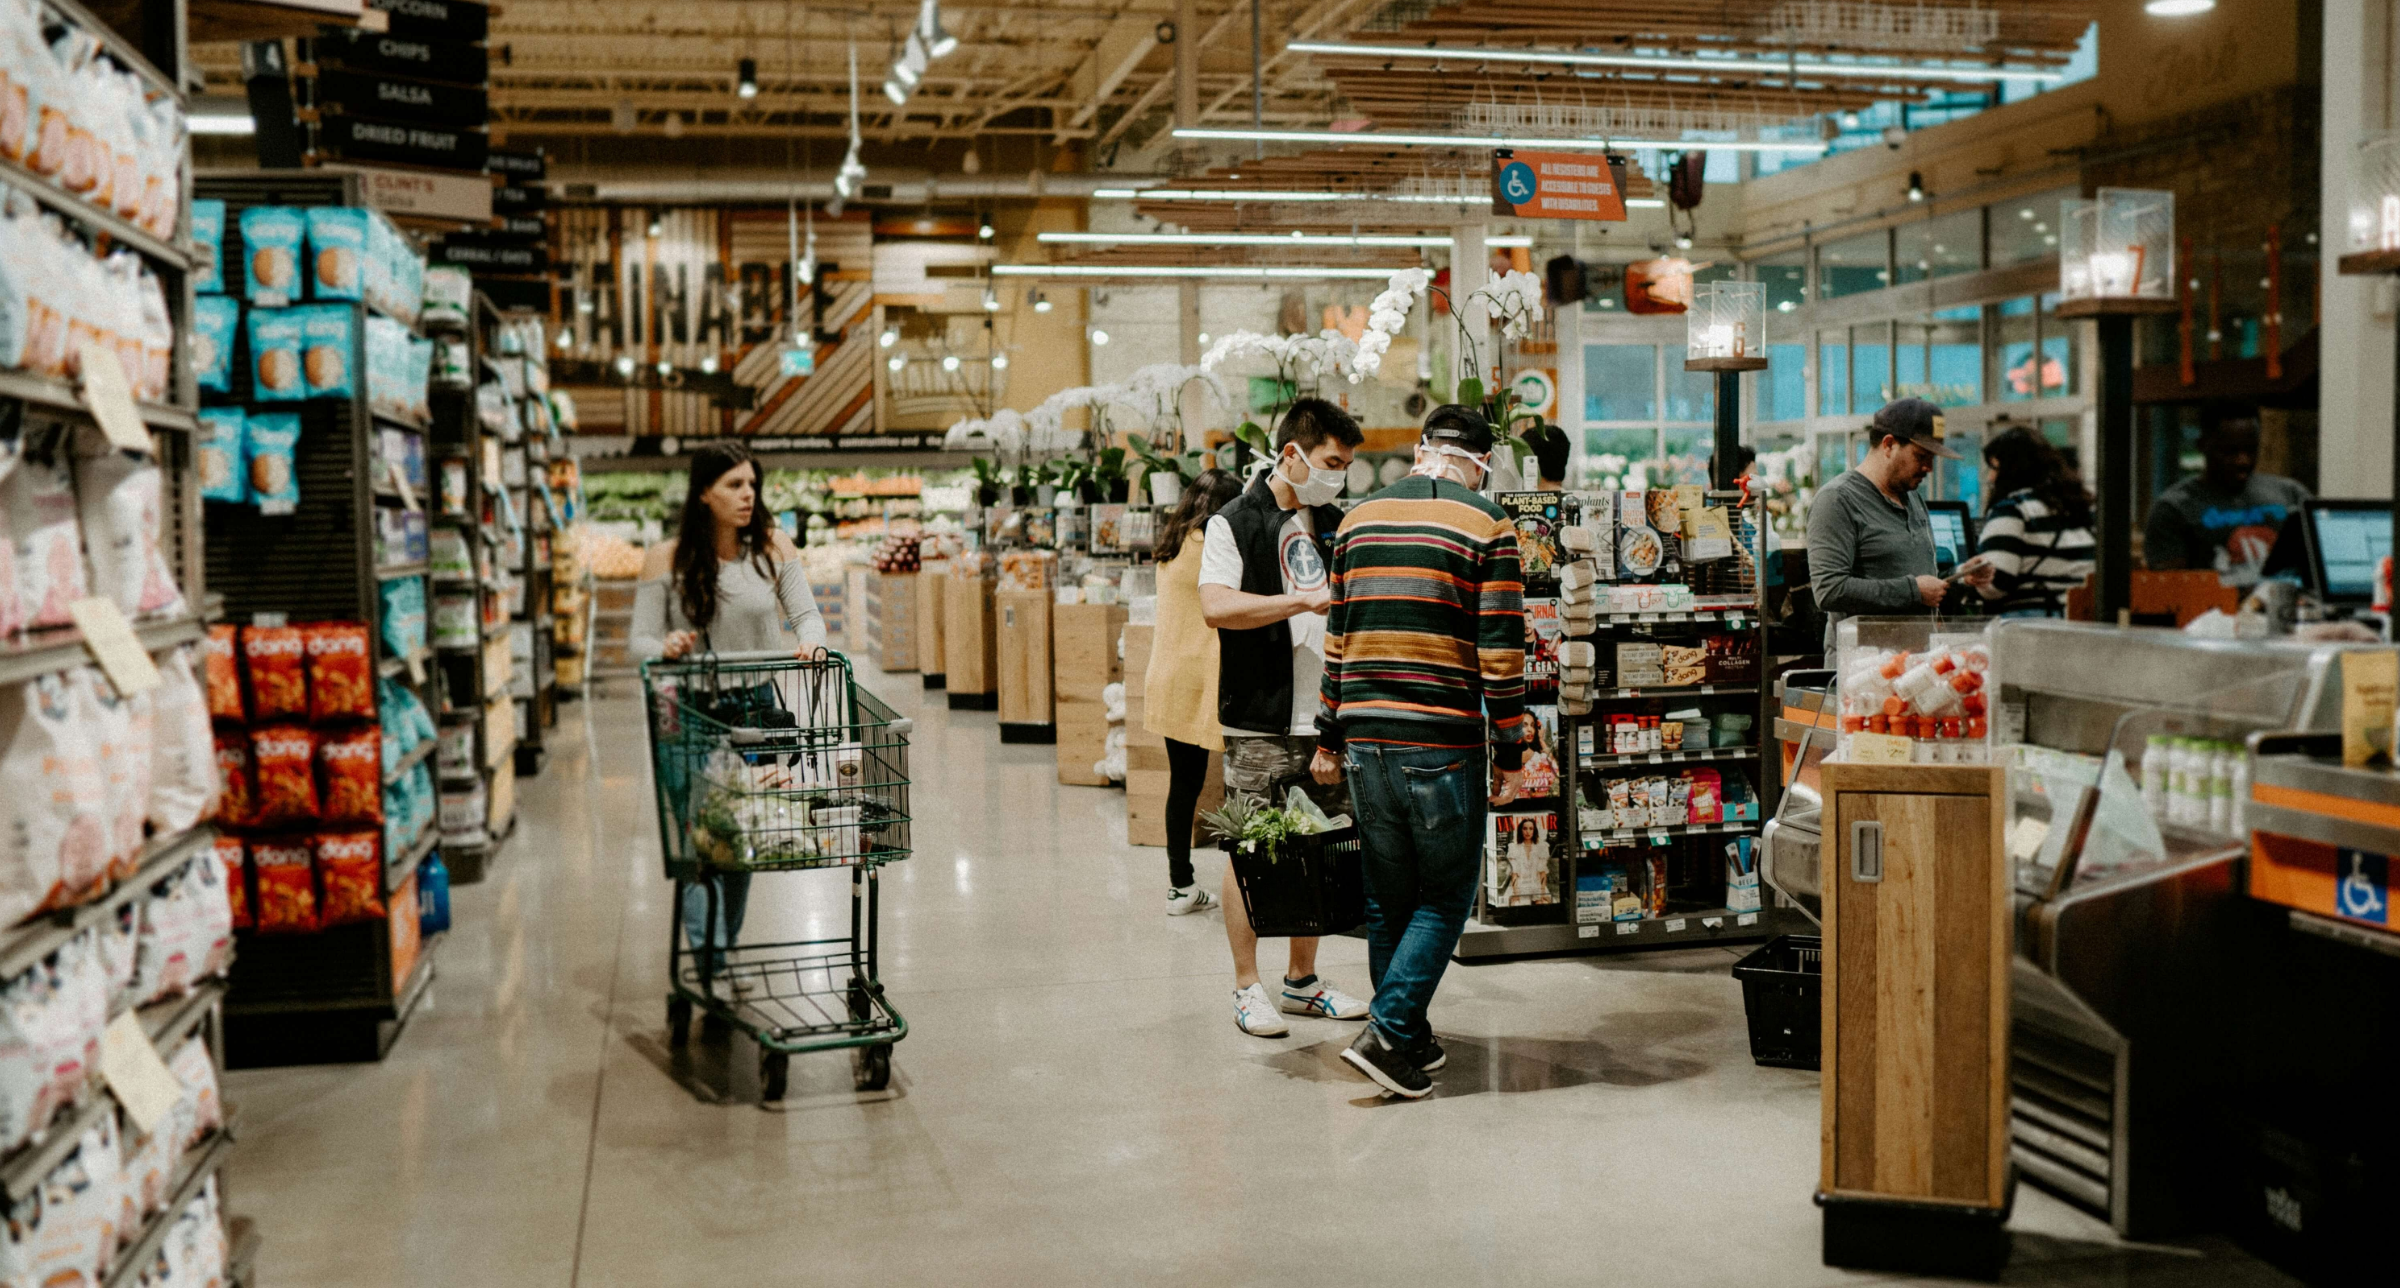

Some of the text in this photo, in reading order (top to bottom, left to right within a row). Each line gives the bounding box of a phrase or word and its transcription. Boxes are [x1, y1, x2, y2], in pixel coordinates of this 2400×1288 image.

[266, 44, 280, 70] 4
[378, 38, 431, 62] CHIPS
[377, 81, 433, 105] SALSA
[353, 123, 458, 151] DRIED FRUIT
[1541, 162, 1552, 174] ALL
[1587, 165, 1599, 178] ARE
[375, 174, 434, 195] CLINT'S
[1579, 181, 1586, 194] TO
[1587, 182, 1611, 195] GUESTS
[1541, 197, 1557, 209] WITH
[1501, 496, 1558, 505] PLANT-BASED
[1581, 496, 1610, 508] plants
[1623, 517, 1644, 526] OVEN
[1678, 650, 1697, 663] dang
[1678, 669, 1697, 681] dang
